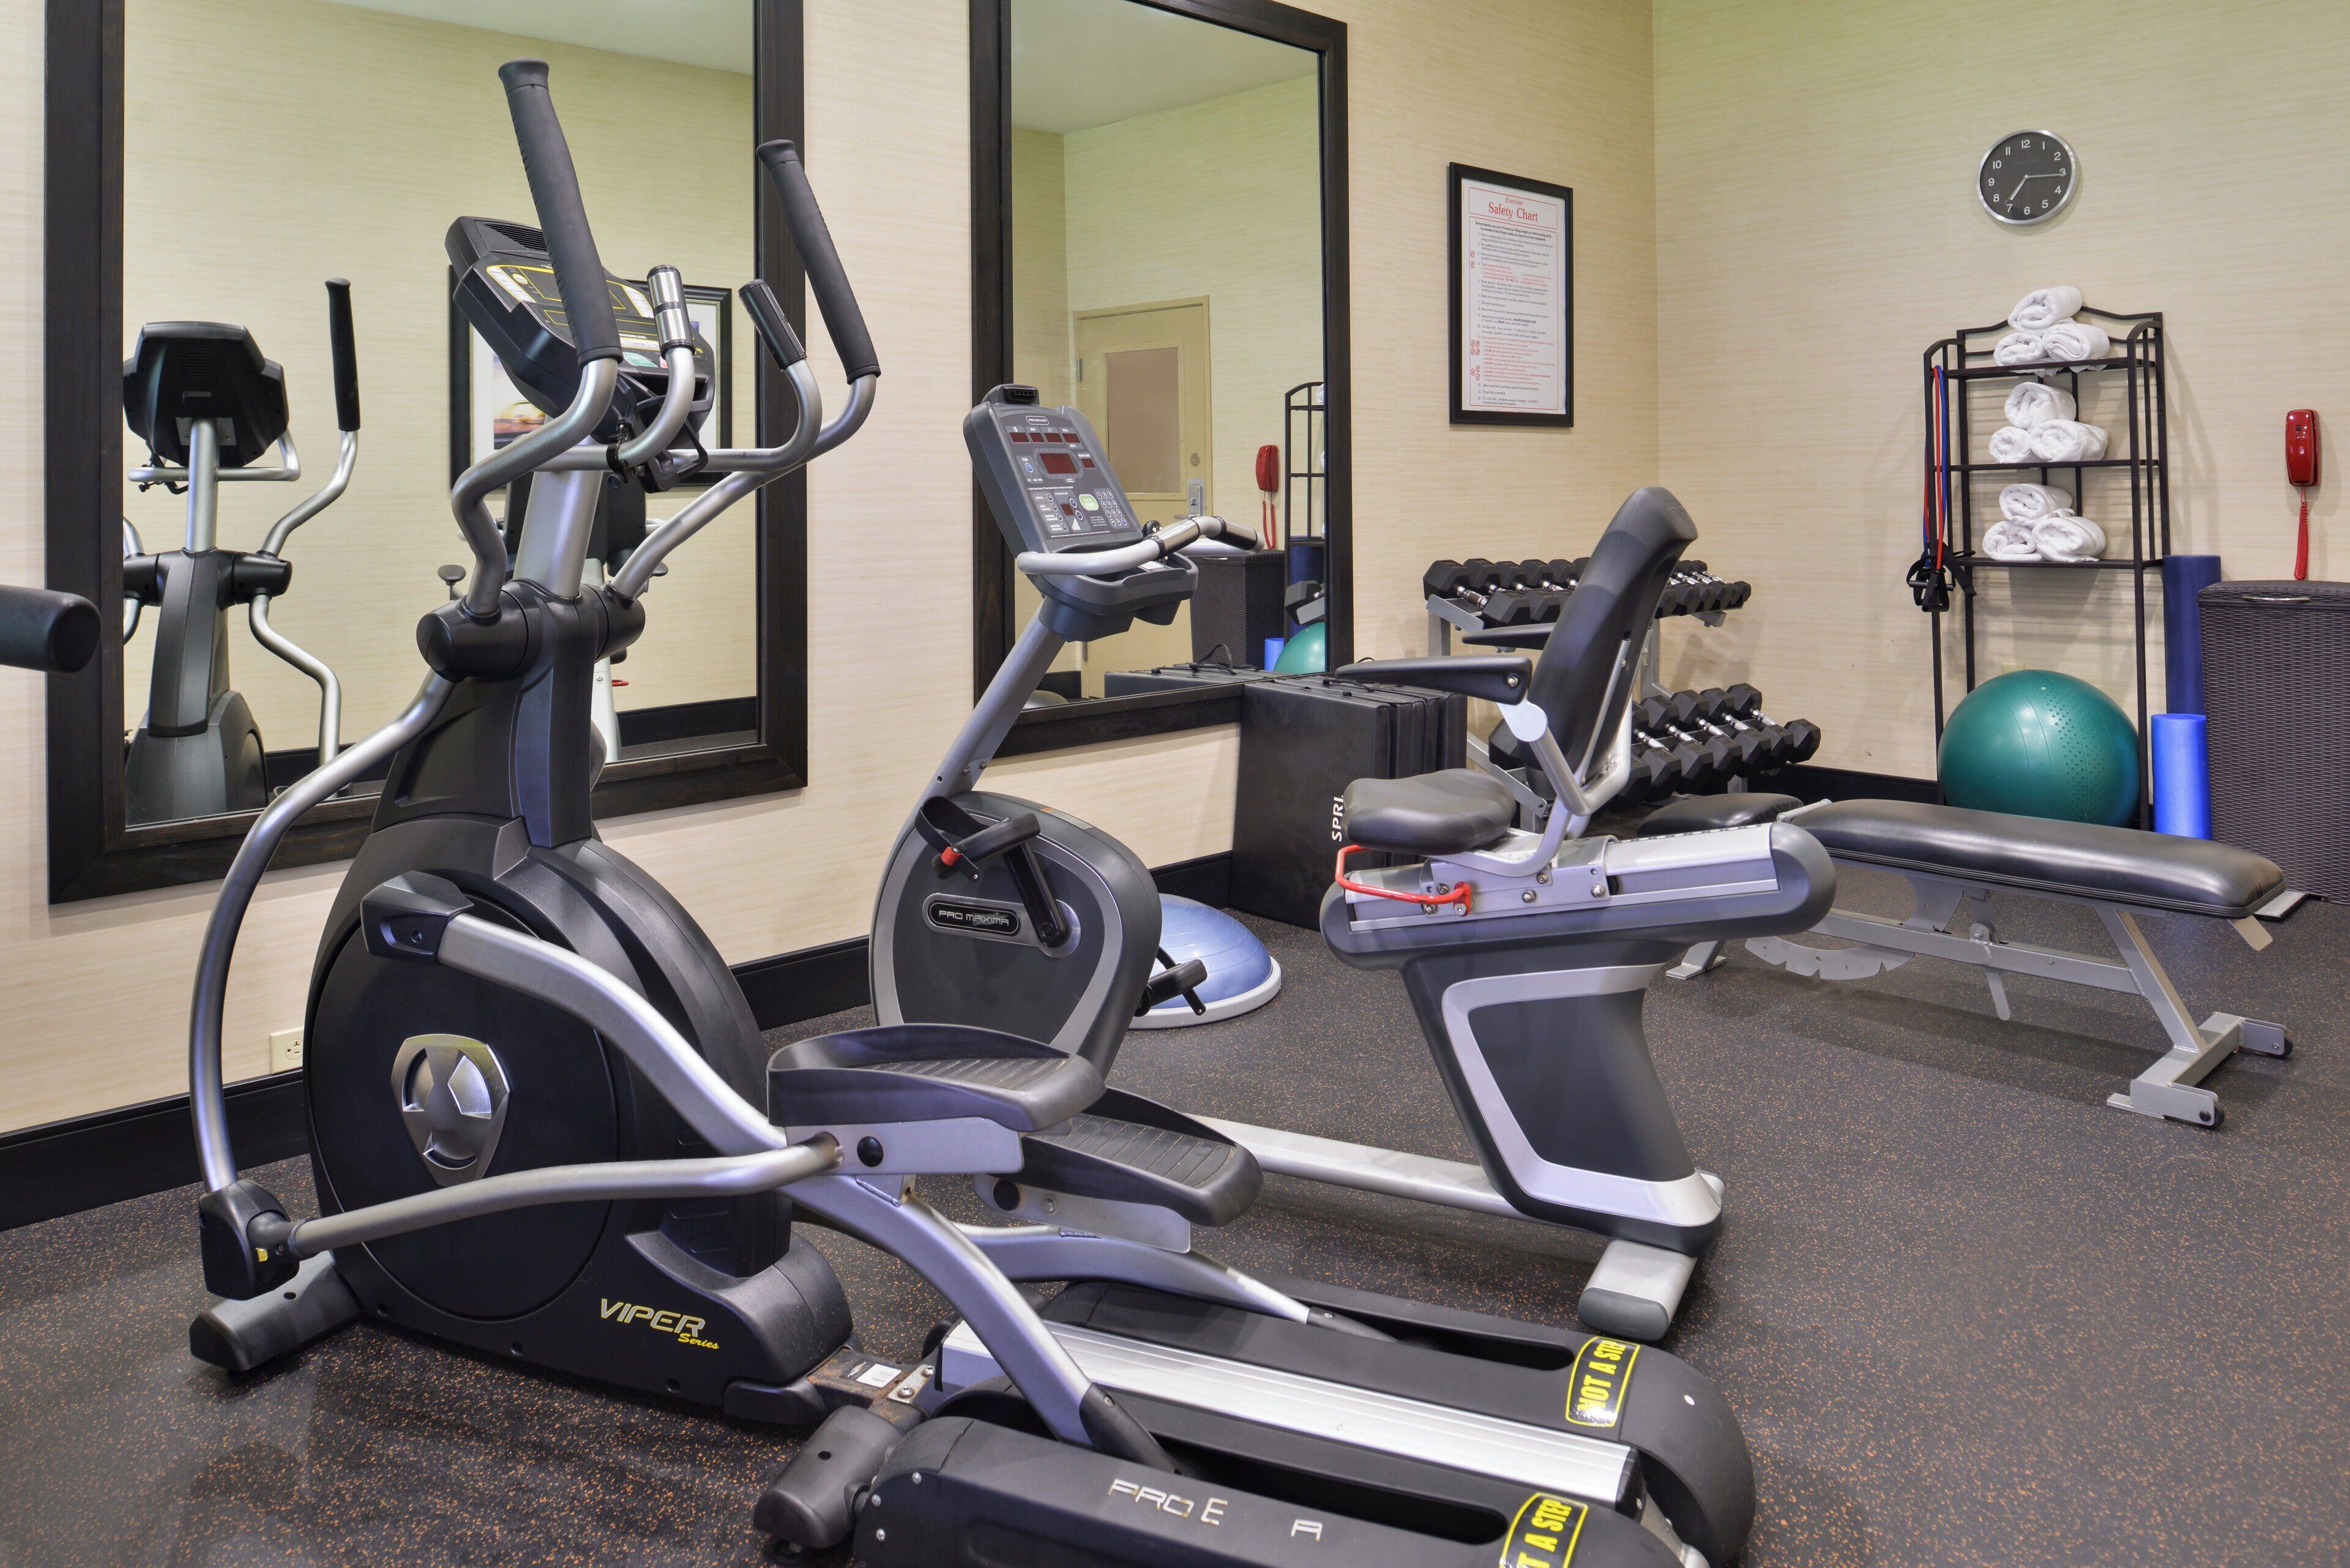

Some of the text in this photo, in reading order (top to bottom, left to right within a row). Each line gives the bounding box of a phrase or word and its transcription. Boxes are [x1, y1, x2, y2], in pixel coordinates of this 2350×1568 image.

[2021, 140, 2031, 149] 12
[2042, 141, 2045, 150] 1
[2005, 146, 2011, 155] 11
[2054, 152, 2061, 161] 2
[1993, 160, 2002, 170] 10
[2059, 168, 2067, 177] 3
[1988, 177, 1995, 186] 9
[2054, 185, 2062, 194] 4
[1505, 196, 1523, 206] Exercise
[1993, 193, 2000, 203] 8
[2006, 204, 2013, 212] 7
[2042, 200, 2048, 209] 5
[1488, 201, 1539, 222] Safety Chart
[2024, 206, 2031, 215] 6
[938, 909, 1010, 927] PRO MAXIMA
[600, 1297, 706, 1338] VIPER
[677, 1332, 720, 1350] Series
[1593, 1339, 1627, 1362] STEP
[1588, 1361, 1617, 1375] A
[1108, 1478, 1195, 1518] PRO
[1531, 1498, 1573, 1532] STEP
[1524, 1533, 1558, 1553] A
